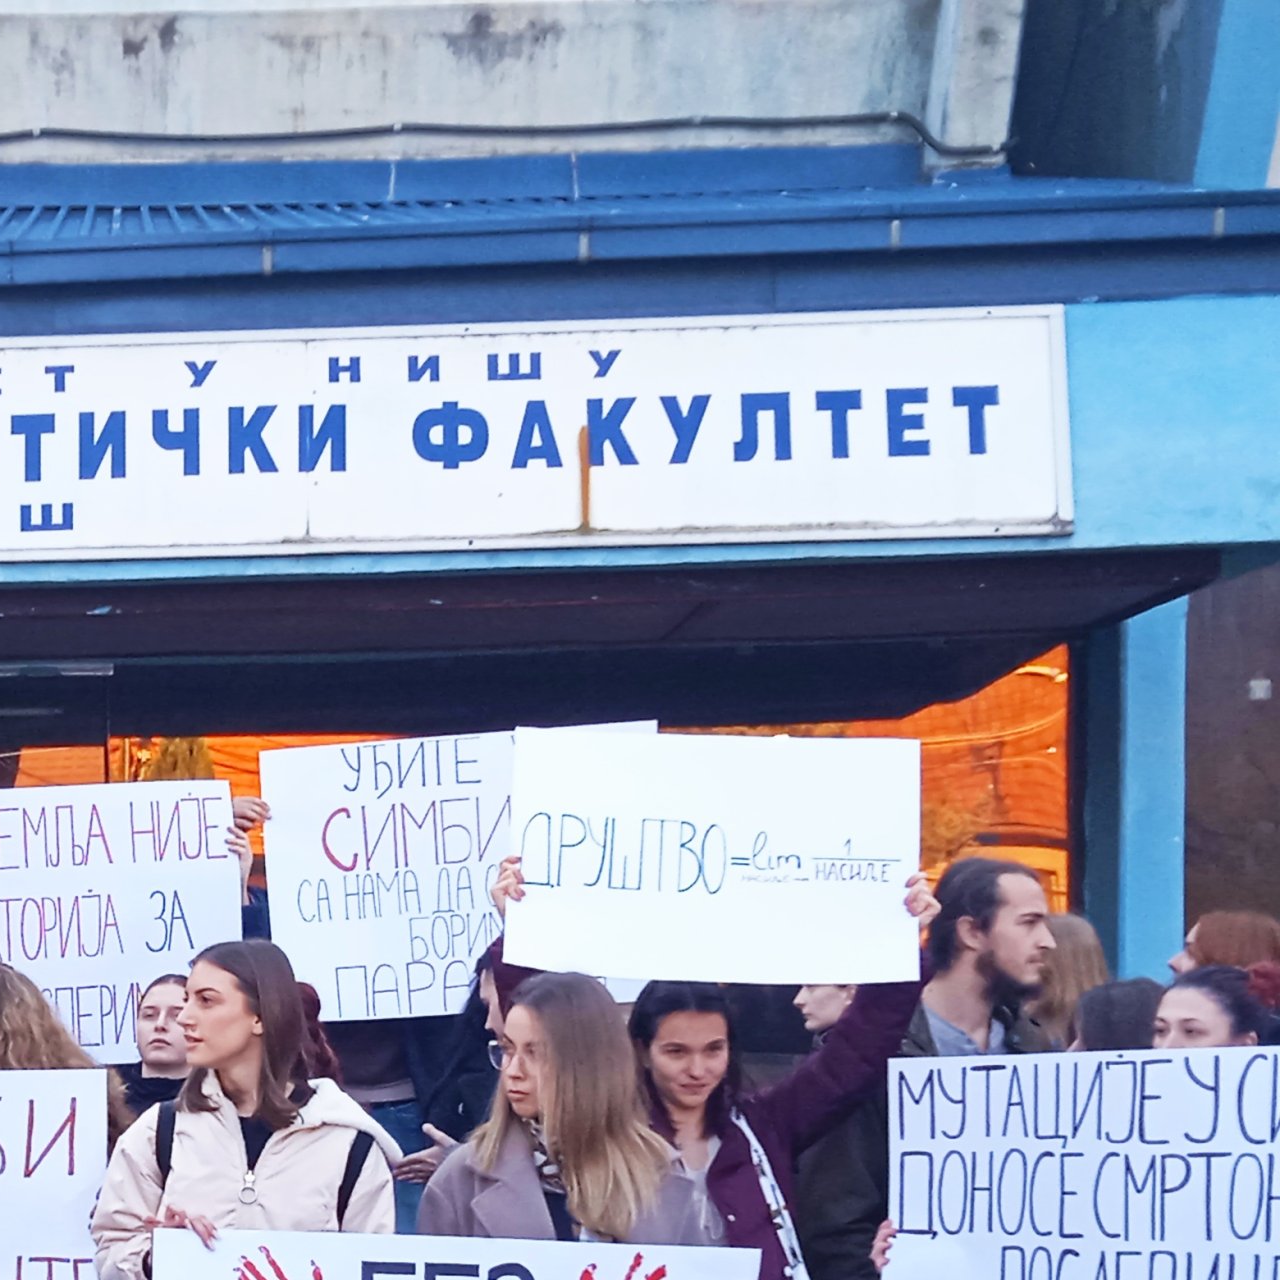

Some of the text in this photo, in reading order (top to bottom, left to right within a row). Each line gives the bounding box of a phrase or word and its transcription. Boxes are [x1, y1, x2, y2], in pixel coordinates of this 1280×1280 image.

[184, 359, 218, 388] У
[327, 350, 622, 383] НИШУ
[412, 385, 1000, 470] ФАКУЛТЕТ
[340, 737, 483, 799] УЂИТЕ
[130, 792, 228, 864] НИЈЕ
[145, 890, 195, 952] ЗА
[297, 878, 333, 922] СА
[344, 869, 421, 921] НАМА
[432, 866, 475, 915] ДА
[897, 1053, 1173, 1149] МУТАЦИЈЕ
[1183, 1055, 1220, 1144] У
[890, 1148, 1085, 1240] ДОНОСЕ
